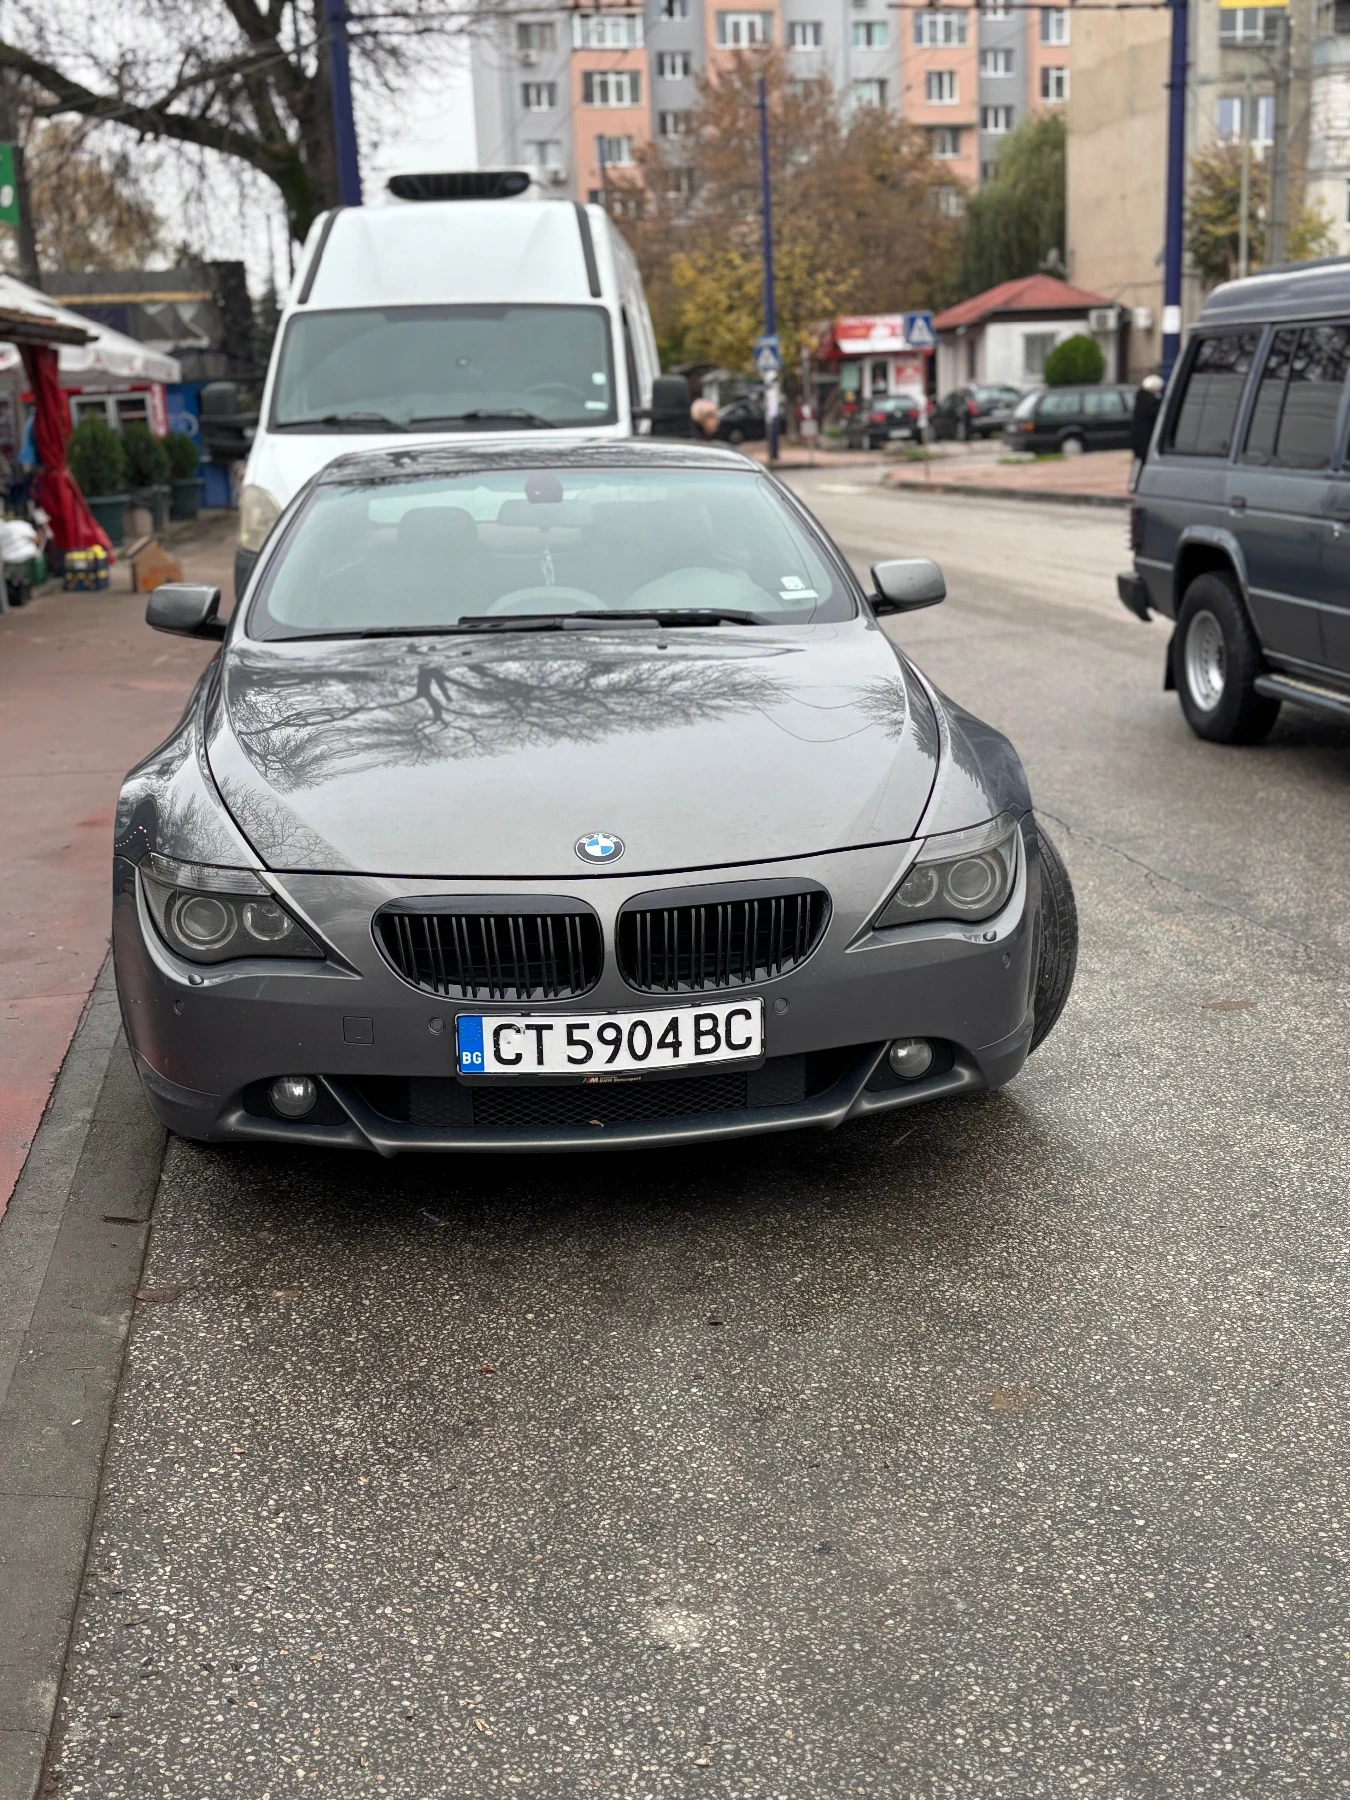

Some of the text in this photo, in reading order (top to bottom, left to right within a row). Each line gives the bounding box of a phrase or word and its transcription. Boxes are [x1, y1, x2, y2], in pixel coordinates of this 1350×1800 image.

[492, 1008, 752, 1065] CT 5904 BC
[462, 1051, 482, 1064] BG
